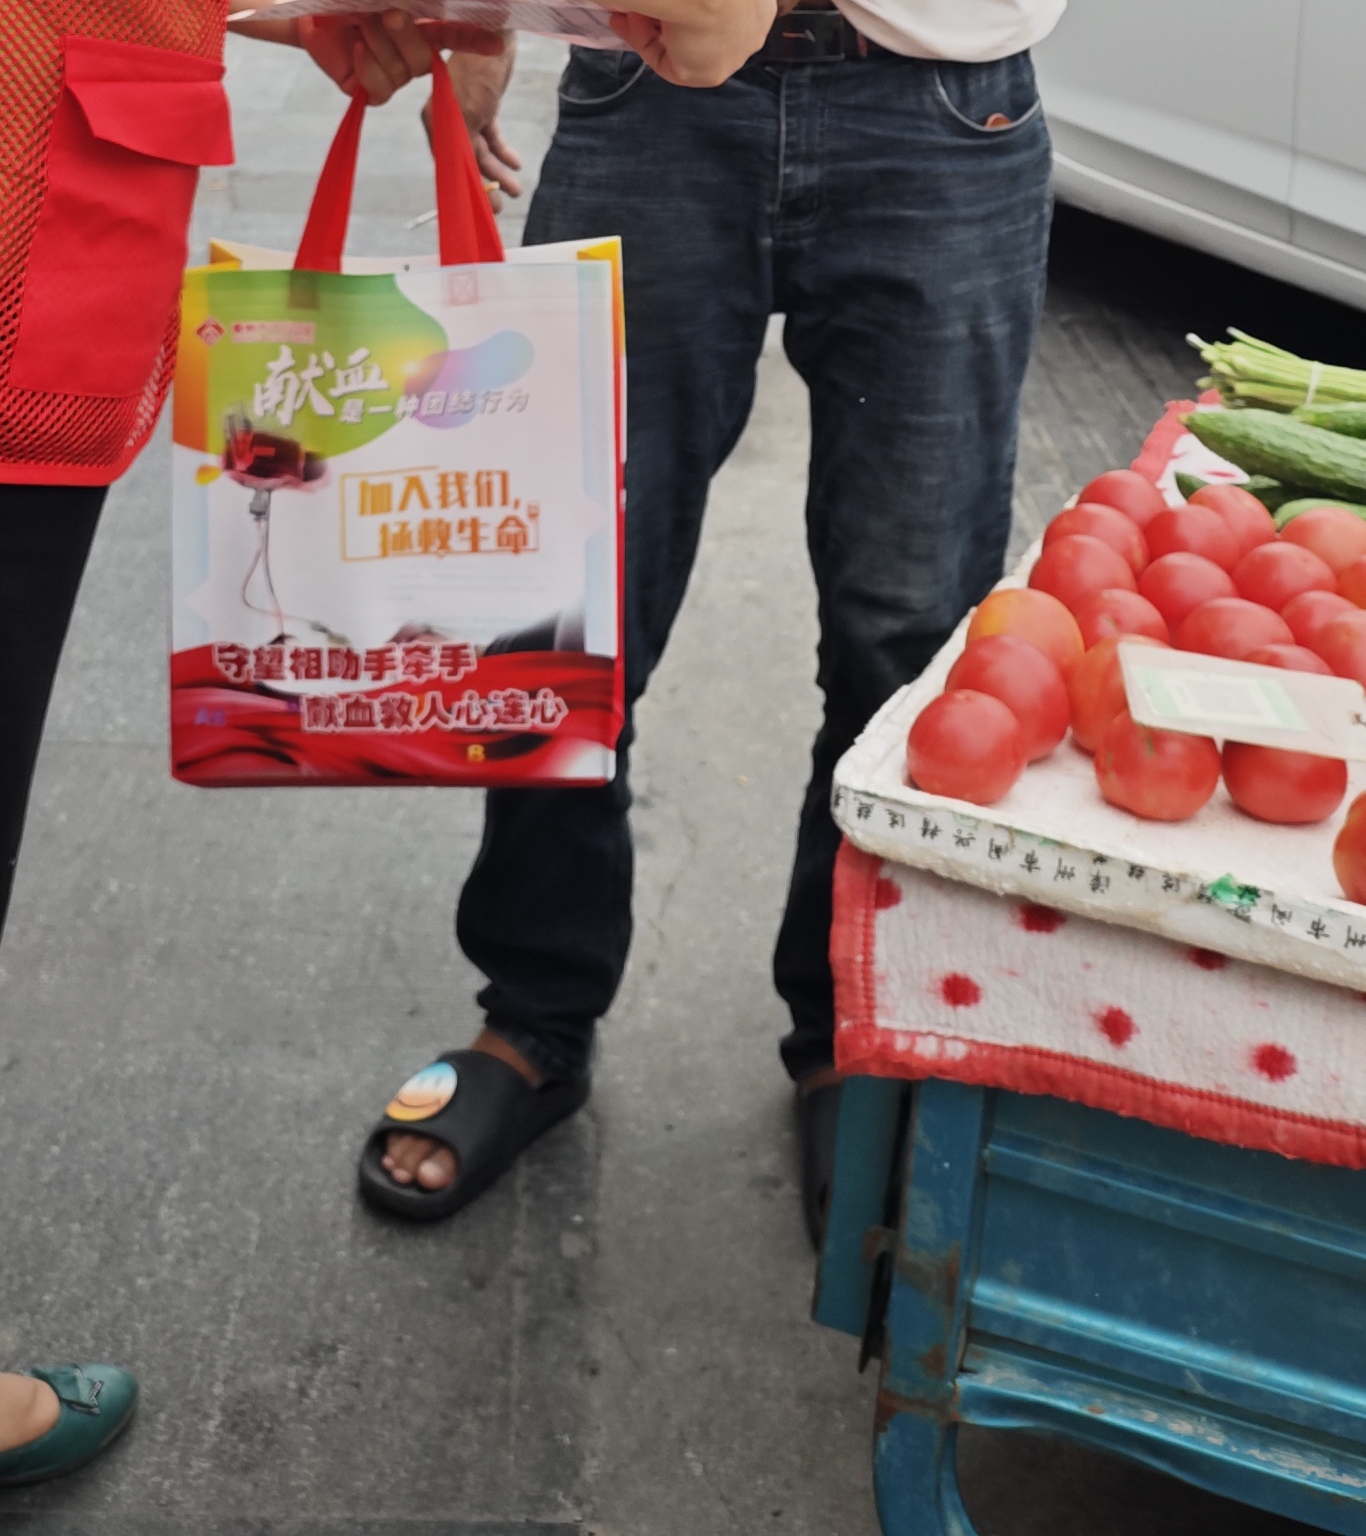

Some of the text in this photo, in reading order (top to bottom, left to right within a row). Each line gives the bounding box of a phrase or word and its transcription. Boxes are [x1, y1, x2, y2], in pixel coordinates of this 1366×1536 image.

[253, 344, 391, 426] 献血
[338, 387, 531, 424] 是一种团结行为
[378, 514, 528, 559] 拯救生命
[213, 641, 478, 684] 守望相助手牵手
[299, 688, 570, 732] 献血救人心连心
